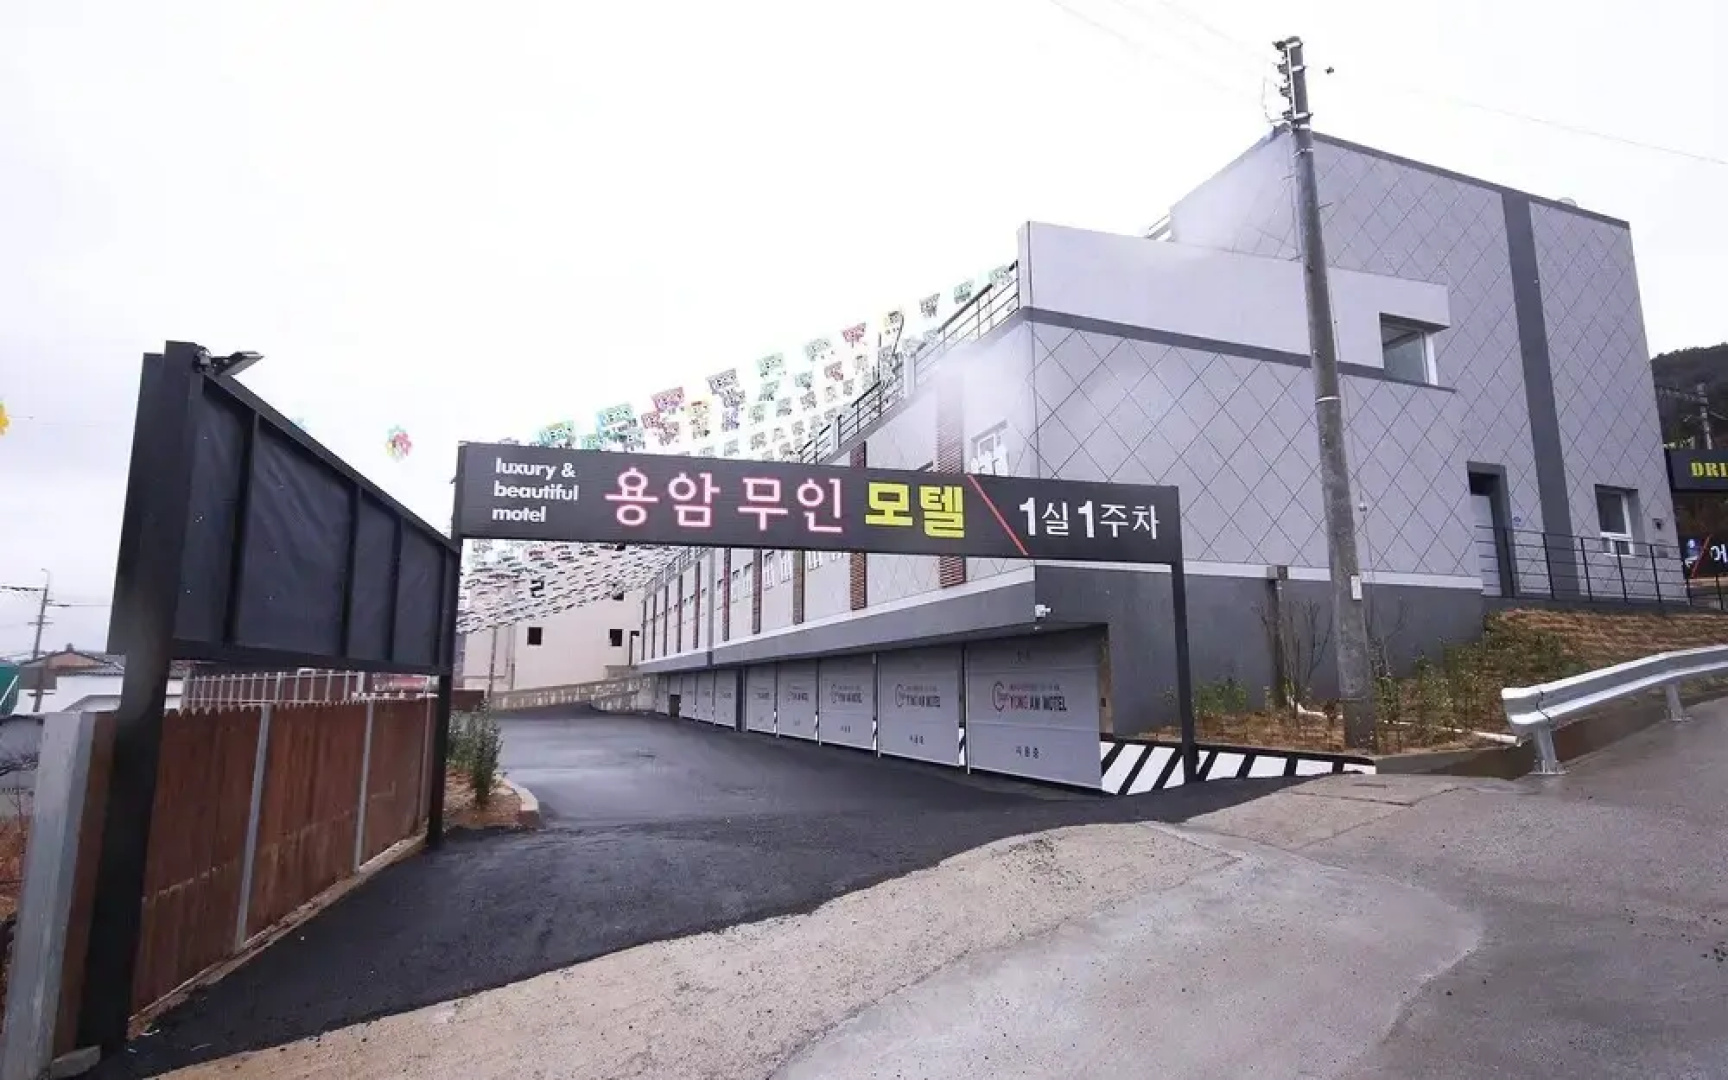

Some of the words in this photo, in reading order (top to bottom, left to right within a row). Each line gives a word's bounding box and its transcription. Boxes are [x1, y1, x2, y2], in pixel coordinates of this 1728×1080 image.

[495, 457, 556, 480] luxury
[561, 463, 576, 478] &
[493, 476, 579, 501] beautiful
[492, 505, 547, 523] motel
[605, 467, 720, 527] 용암
[738, 478, 842, 533] 무인
[865, 481, 965, 538] 모텔
